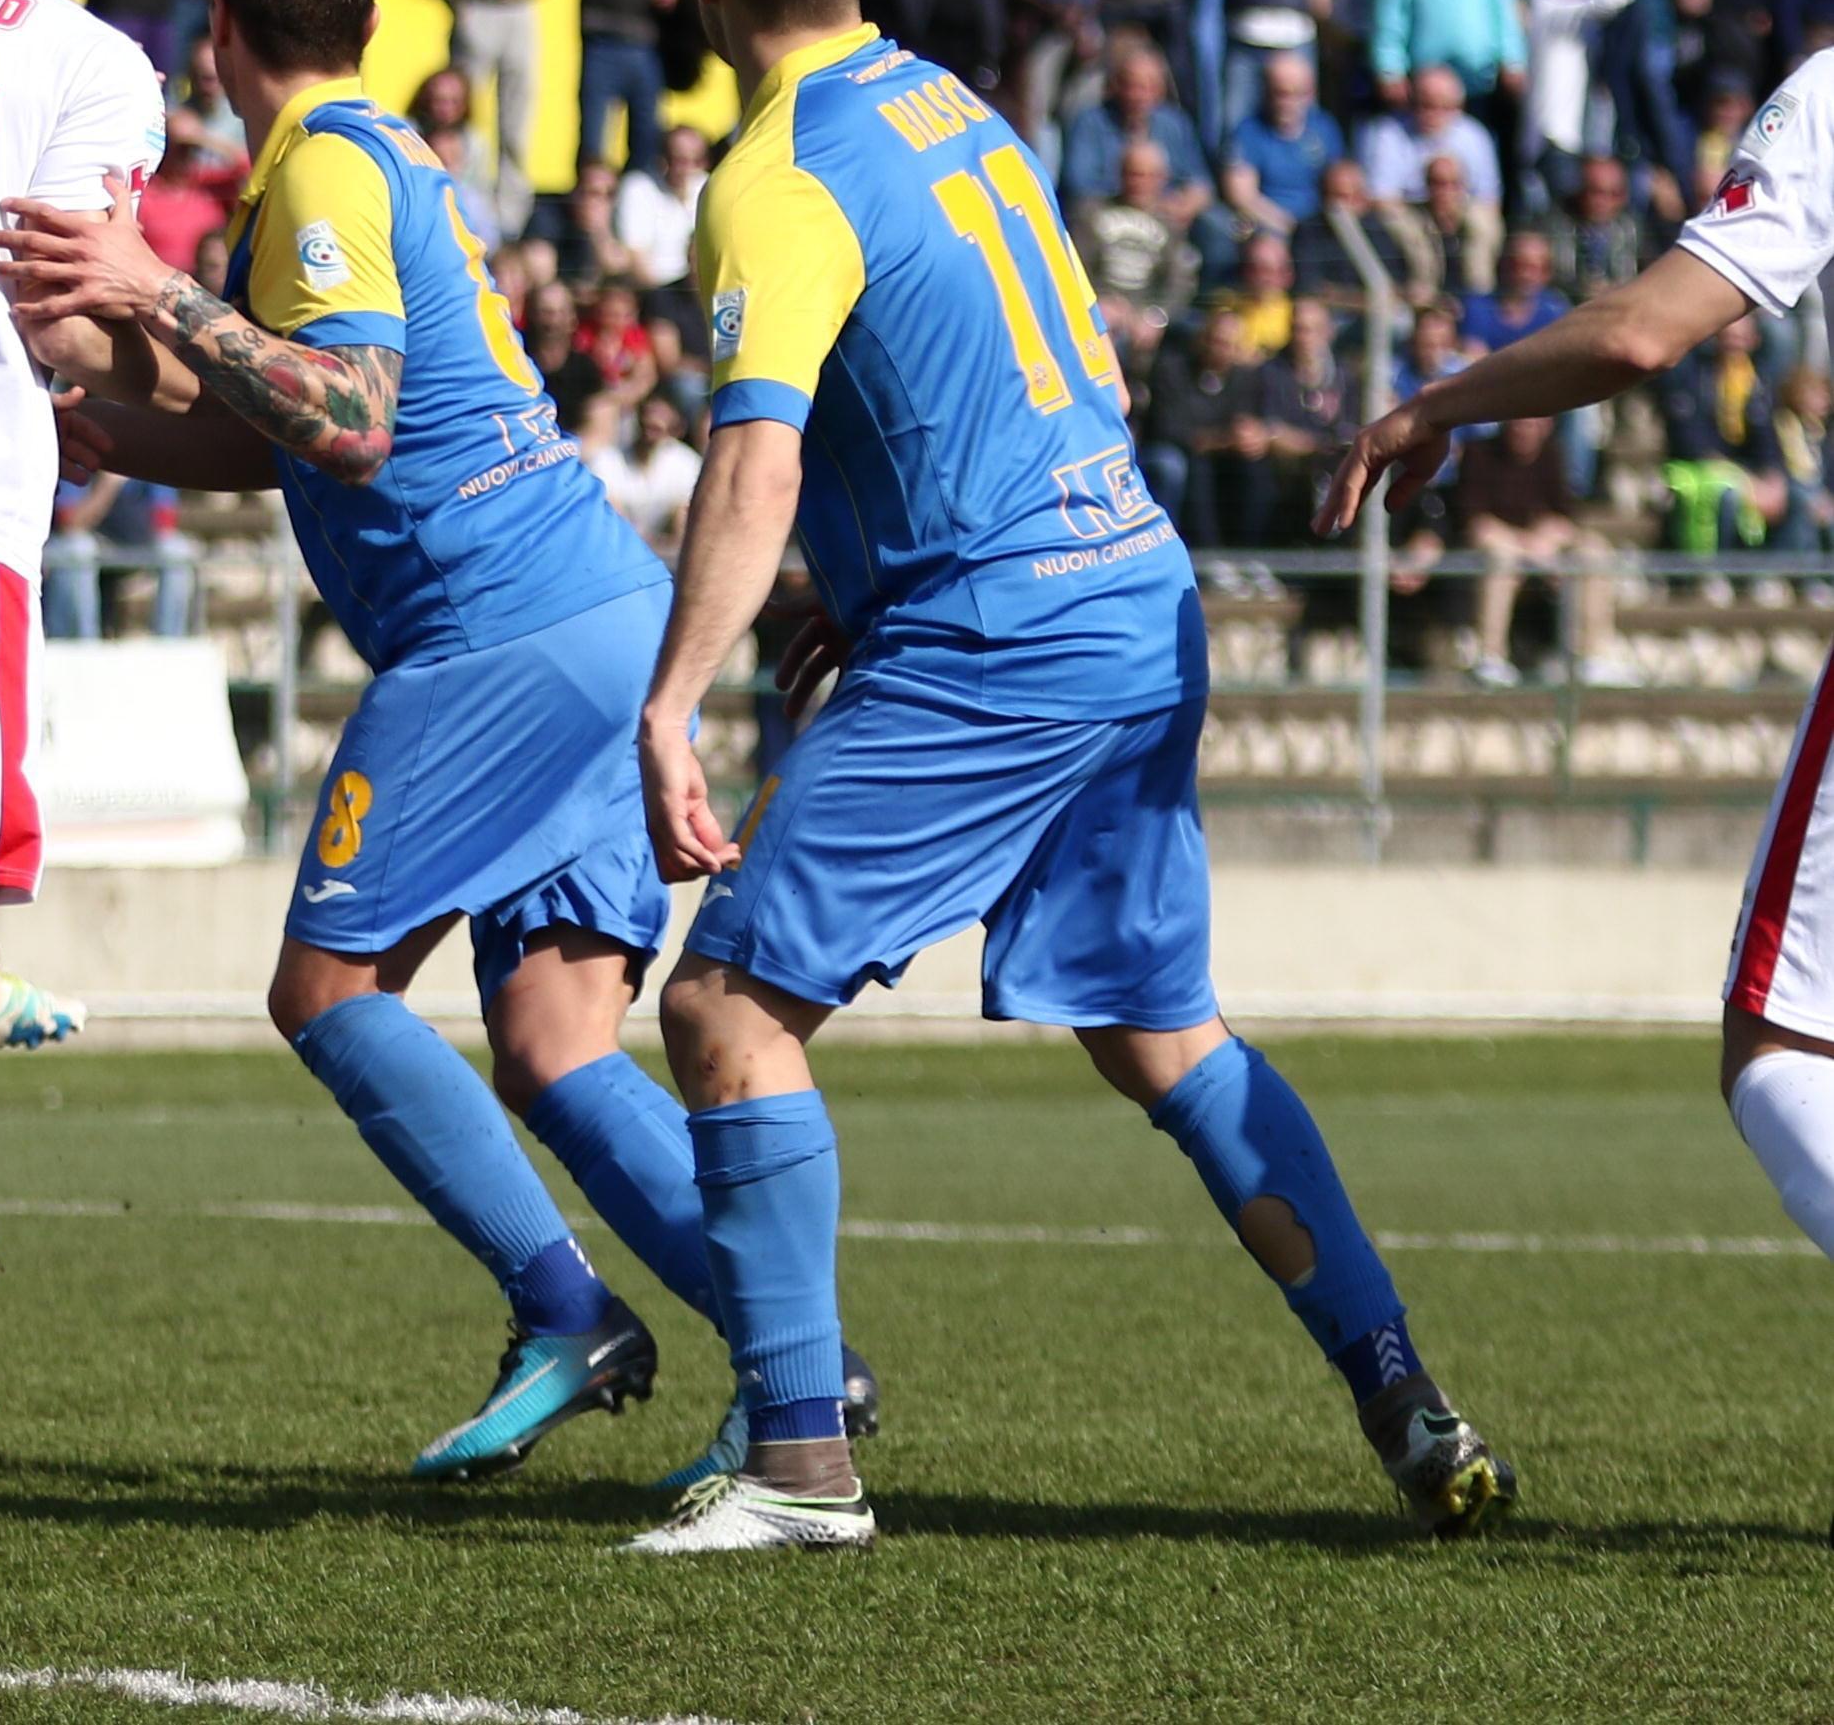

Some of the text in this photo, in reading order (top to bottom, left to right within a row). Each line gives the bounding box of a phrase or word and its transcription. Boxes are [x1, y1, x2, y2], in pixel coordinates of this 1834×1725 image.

[931, 144, 1115, 416] 11
[458, 460, 520, 501] NUOVI
[1033, 547, 1099, 580] NUOVI
[1102, 528, 1159, 565] CANTIERI
[318, 770, 373, 868] 8
